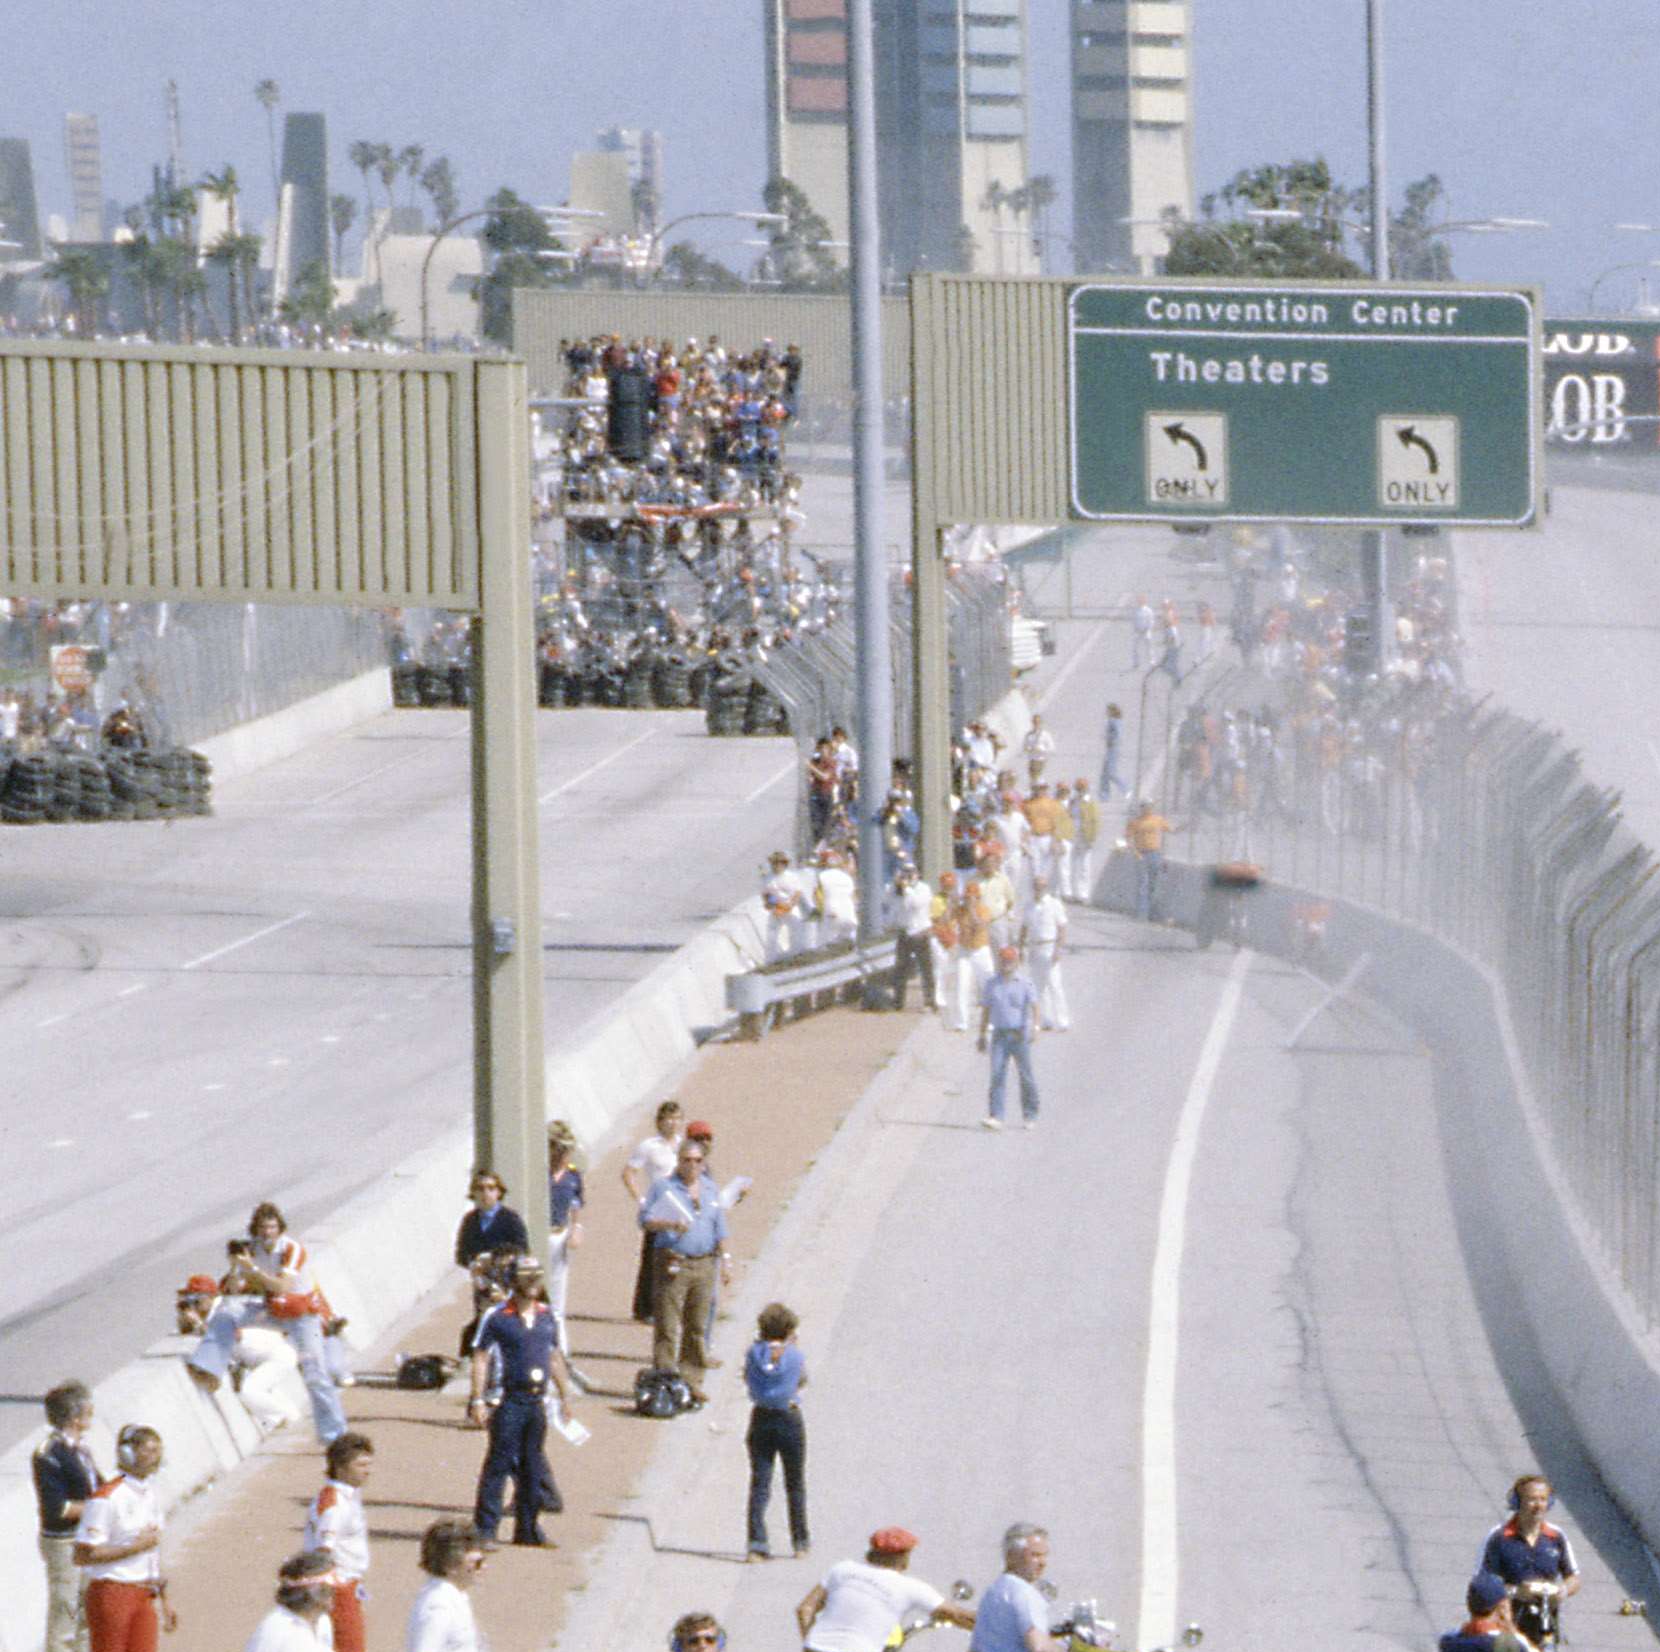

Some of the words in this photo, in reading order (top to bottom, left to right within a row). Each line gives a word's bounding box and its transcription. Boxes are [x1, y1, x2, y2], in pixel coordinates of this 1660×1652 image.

[1146, 296, 1328, 325] Convention
[1352, 301, 1458, 326] Center
[1151, 352, 1330, 385] Theaters
[1551, 373, 1626, 443] OB
[1387, 481, 1451, 501] ONLY
